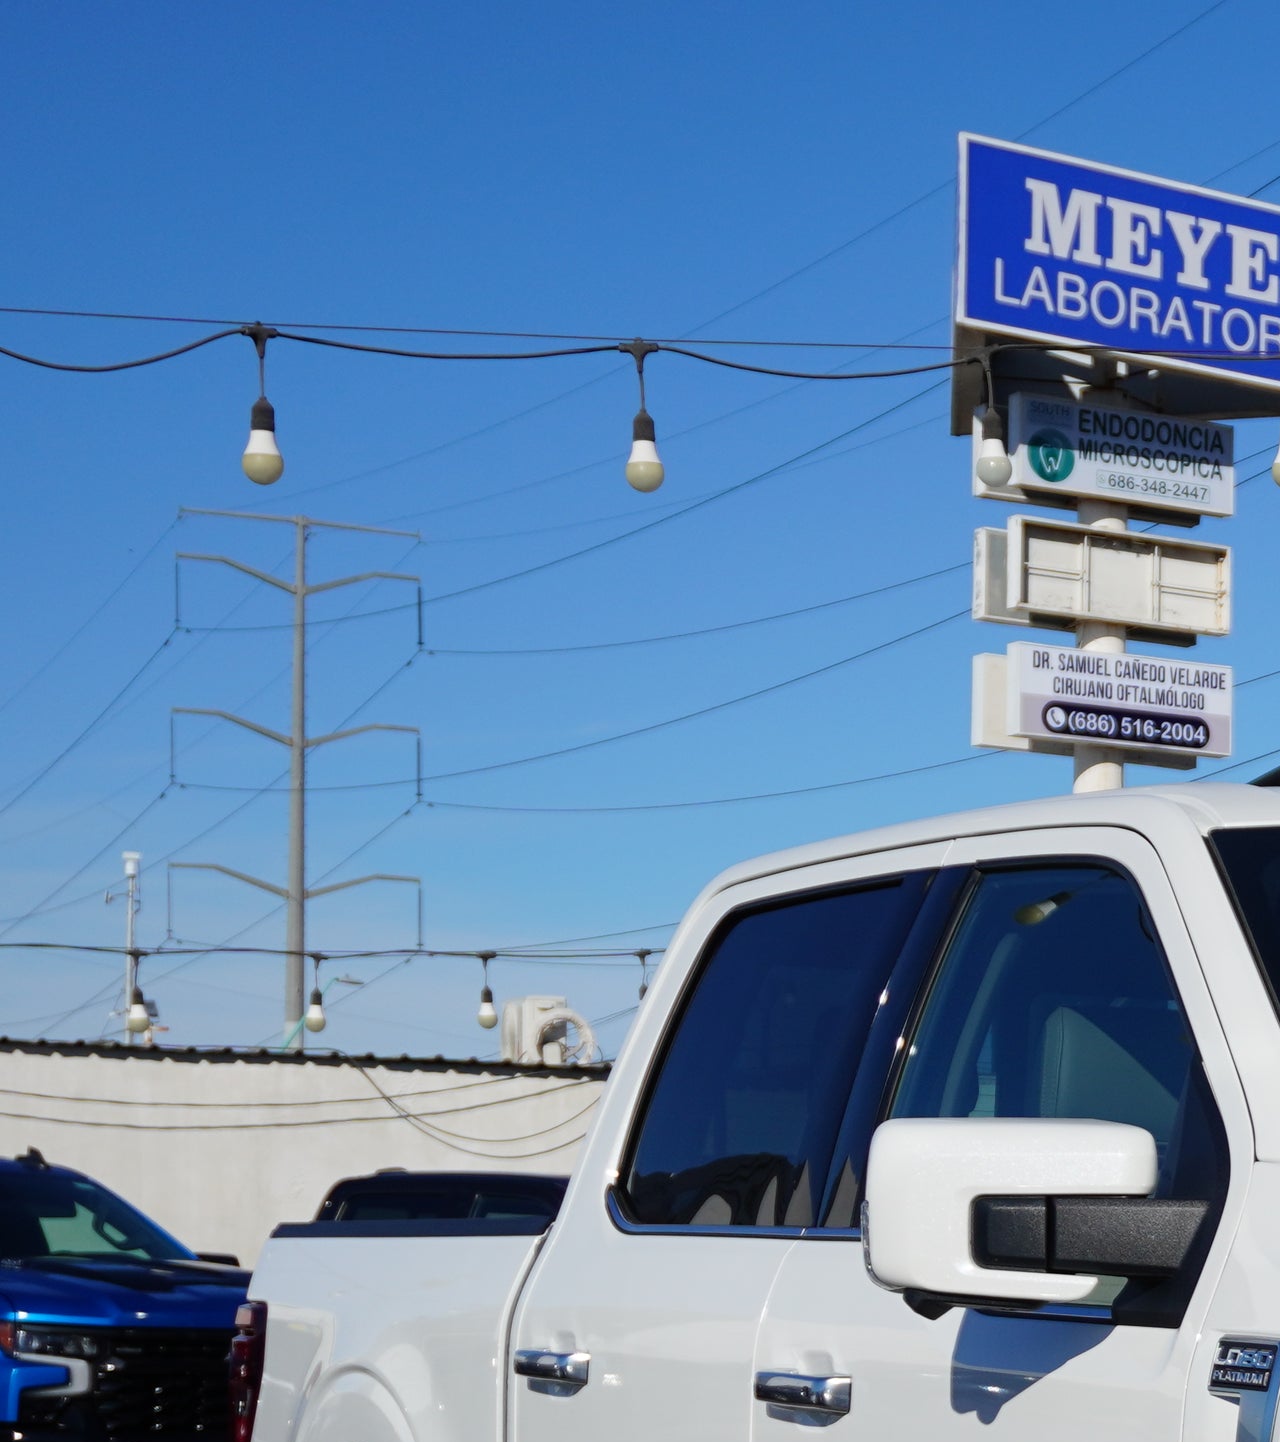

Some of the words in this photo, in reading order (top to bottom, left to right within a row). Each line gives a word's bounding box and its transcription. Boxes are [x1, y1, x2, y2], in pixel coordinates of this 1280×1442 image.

[1078, 408, 1224, 454] ENDODONCIA
[1078, 438, 1223, 481] MICROSCOPICA
[1108, 473, 1208, 501] 686-348-2447
[1032, 650, 1054, 670] DR.
[1058, 653, 1111, 678] SAMUEL
[1115, 658, 1166, 683] CAÑEDO
[1170, 666, 1226, 690] VELARDE
[1053, 676, 1113, 700] CIRUJANO
[1116, 683, 1205, 710] OFTALMÓLOGO
[1068, 710, 1116, 734] (686)
[1121, 717, 1206, 744] 516-2004
[1213, 1369, 1263, 1385] PLATINUM
